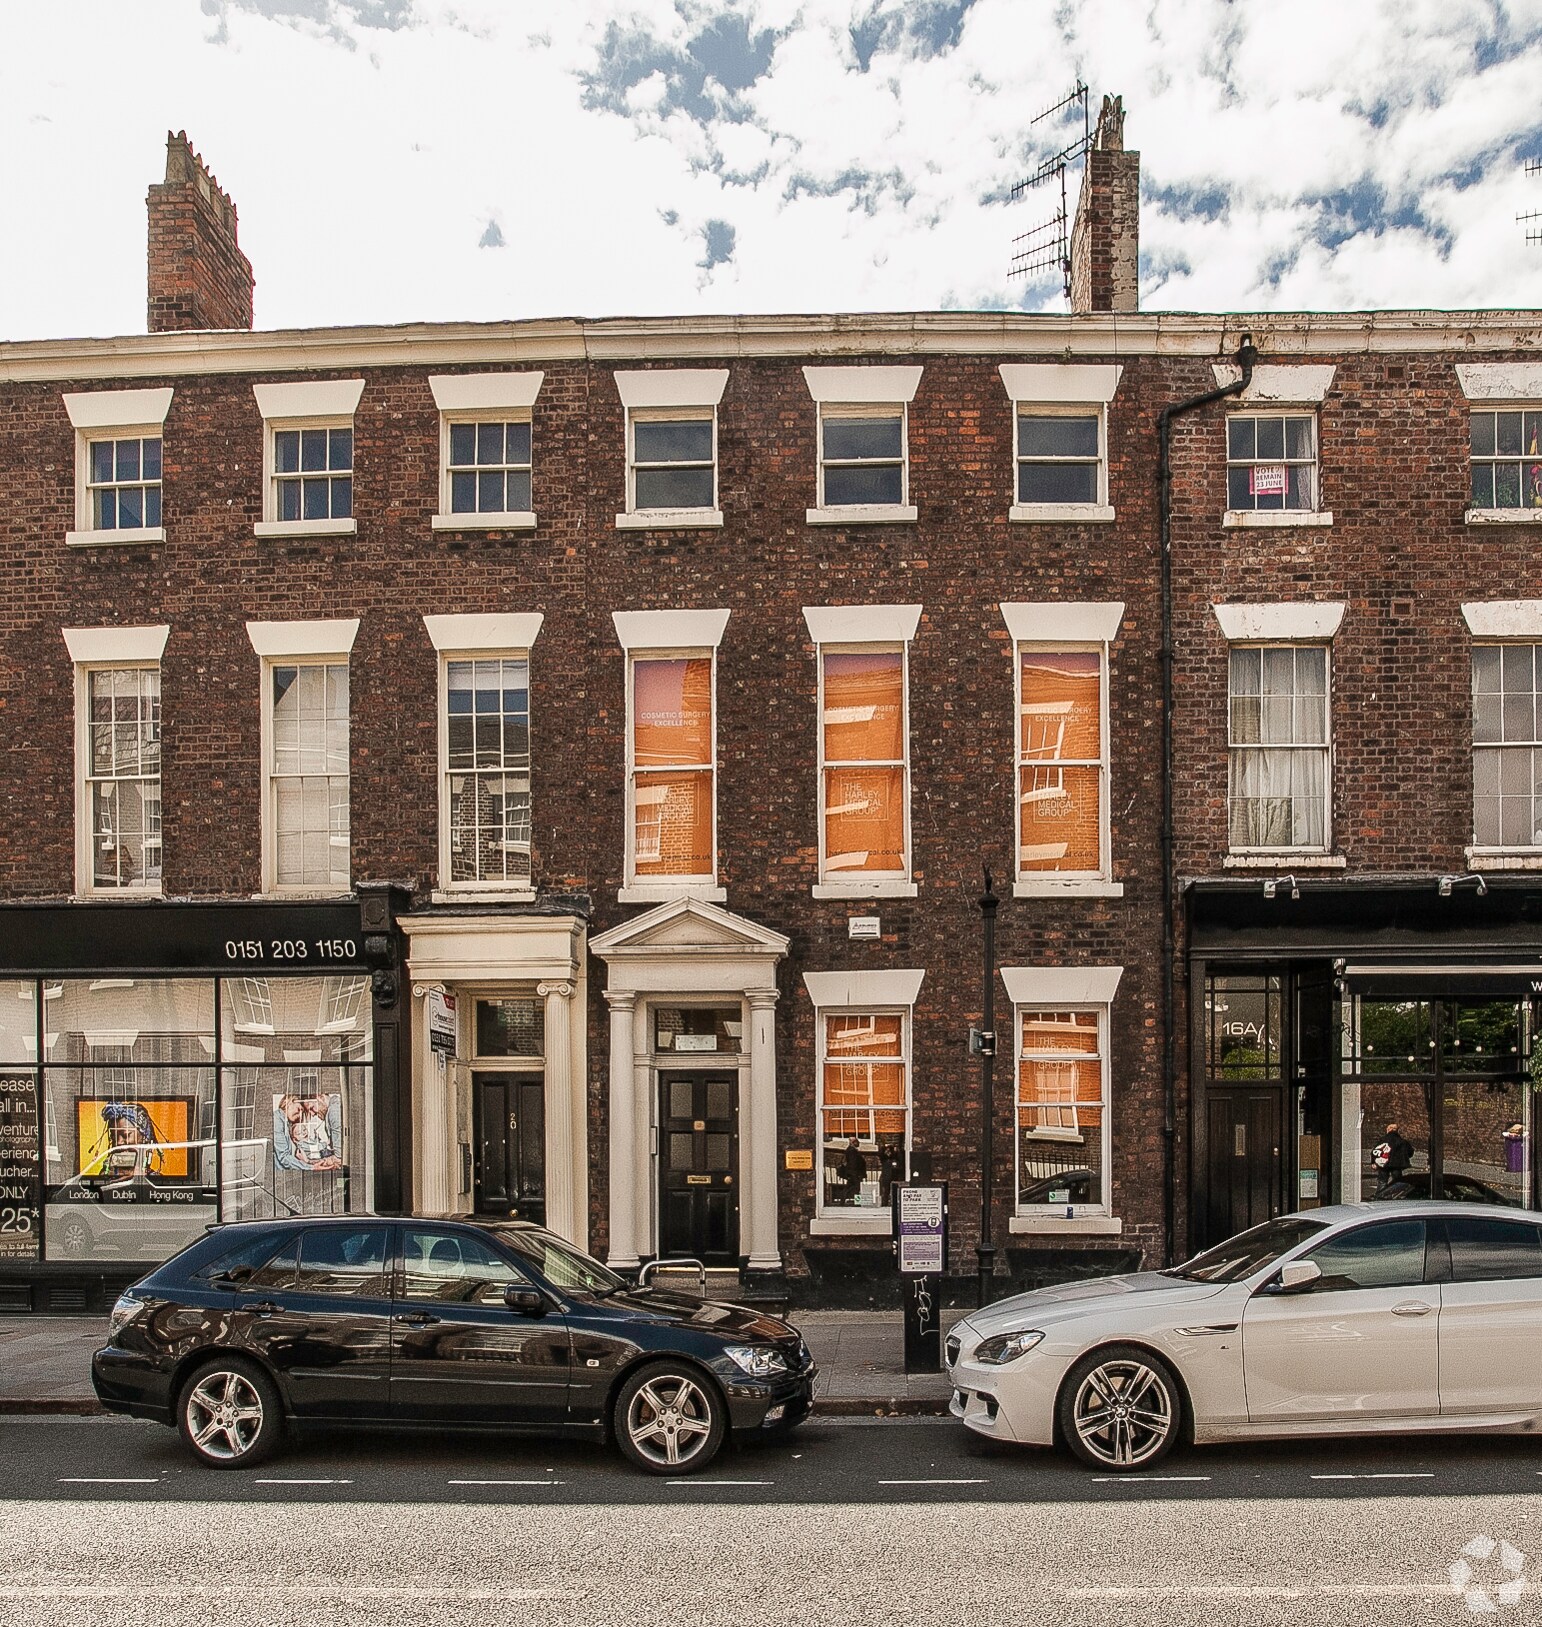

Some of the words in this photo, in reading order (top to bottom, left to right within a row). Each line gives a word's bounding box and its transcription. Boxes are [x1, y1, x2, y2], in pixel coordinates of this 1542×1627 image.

[1256, 466, 1275, 475] VOTE
[1256, 474, 1282, 482] REMAIN
[1265, 480, 1283, 488] JUNE
[641, 711, 677, 719] COSMETIC
[679, 711, 711, 719] SURGERY
[654, 719, 699, 727] EXCELLENCE
[844, 783, 862, 791] THE
[845, 791, 879, 799] HARLEY
[1038, 800, 1076, 809] MEDICAL
[1038, 809, 1069, 817] GROUP
[226, 940, 264, 959] 0151
[271, 940, 308, 958] 203
[316, 939, 356, 958] 1150
[1222, 1022, 1258, 1035] 16A
[1039, 1037, 1056, 1045] THE
[1039, 1045, 1072, 1053] HARLEY
[0, 1080, 35, 1092] ease
[0, 1186, 29, 1199] ONLY
[69, 1190, 99, 1199] London
[112, 1190, 136, 1199] Dublin
[149, 1190, 171, 1200] Hong
[172, 1190, 193, 1201] Kong
